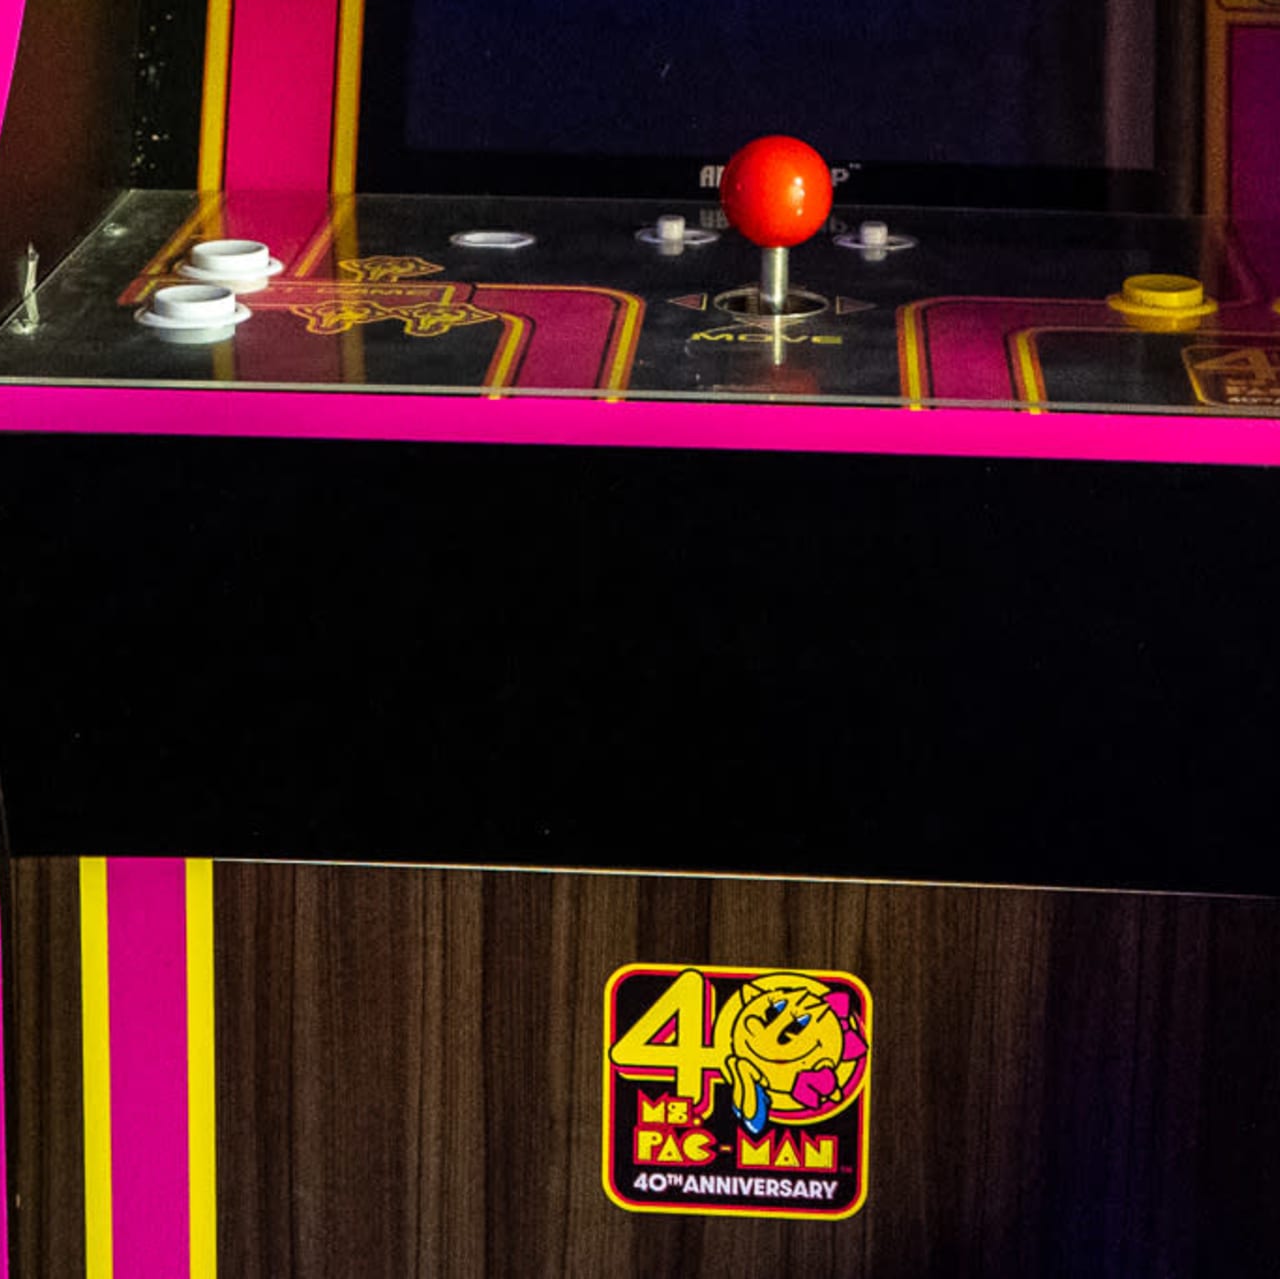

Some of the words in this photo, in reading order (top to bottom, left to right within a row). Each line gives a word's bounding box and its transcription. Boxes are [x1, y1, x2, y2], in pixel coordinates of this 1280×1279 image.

[690, 331, 844, 346] MOVE
[635, 1128, 837, 1170] PAC-MAN
[682, 1175, 839, 1200] ANNIVERSARY
